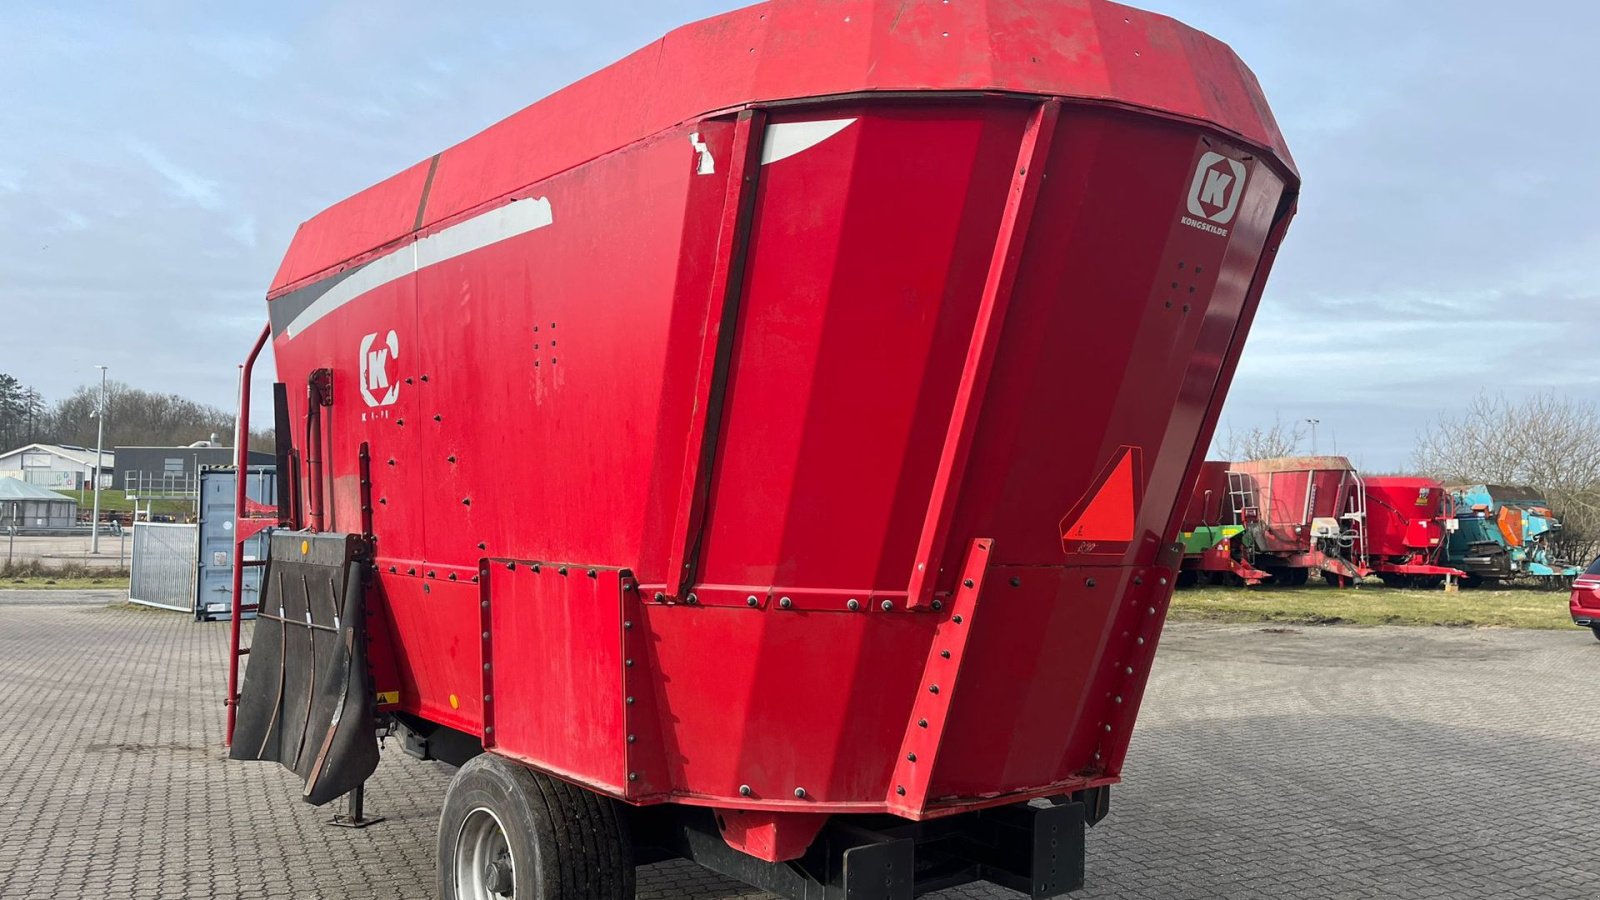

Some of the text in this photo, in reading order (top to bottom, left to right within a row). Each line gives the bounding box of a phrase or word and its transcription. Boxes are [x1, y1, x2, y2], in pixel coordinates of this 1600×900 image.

[1201, 169, 1233, 208] K
[1181, 216, 1228, 237] KONGSKILDE
[368, 348, 389, 390] K
